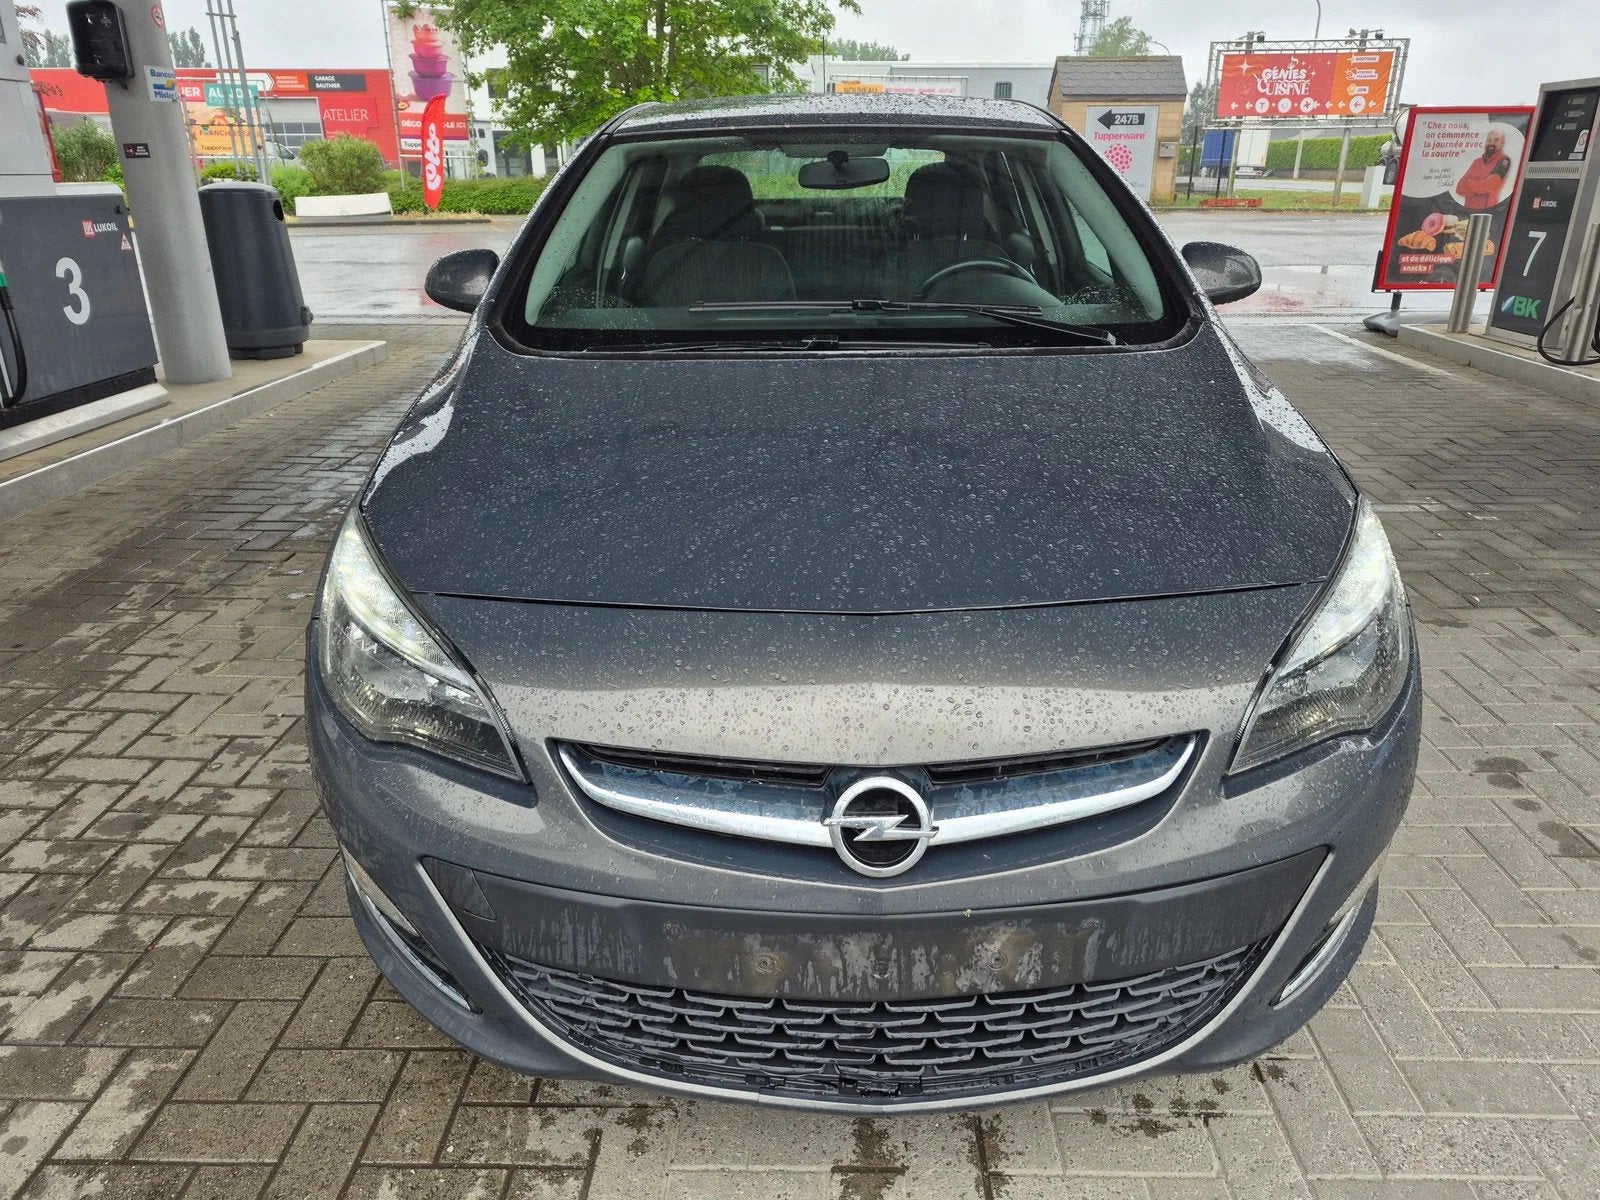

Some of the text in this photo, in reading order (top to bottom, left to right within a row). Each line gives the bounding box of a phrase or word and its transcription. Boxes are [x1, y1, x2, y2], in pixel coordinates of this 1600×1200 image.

[1262, 66, 1306, 80] GÉNIES
[1257, 78, 1310, 95] CUISINE
[323, 108, 370, 121] ATELIER
[1114, 114, 1140, 125] 247B
[1094, 131, 1146, 141] Tupperware
[1432, 140, 1464, 149] journée
[93, 222, 118, 233] LUKOIL
[1409, 254, 1419, 262] de
[1522, 230, 1547, 277] 7
[56, 257, 91, 325] 3
[1513, 296, 1542, 320] BK
